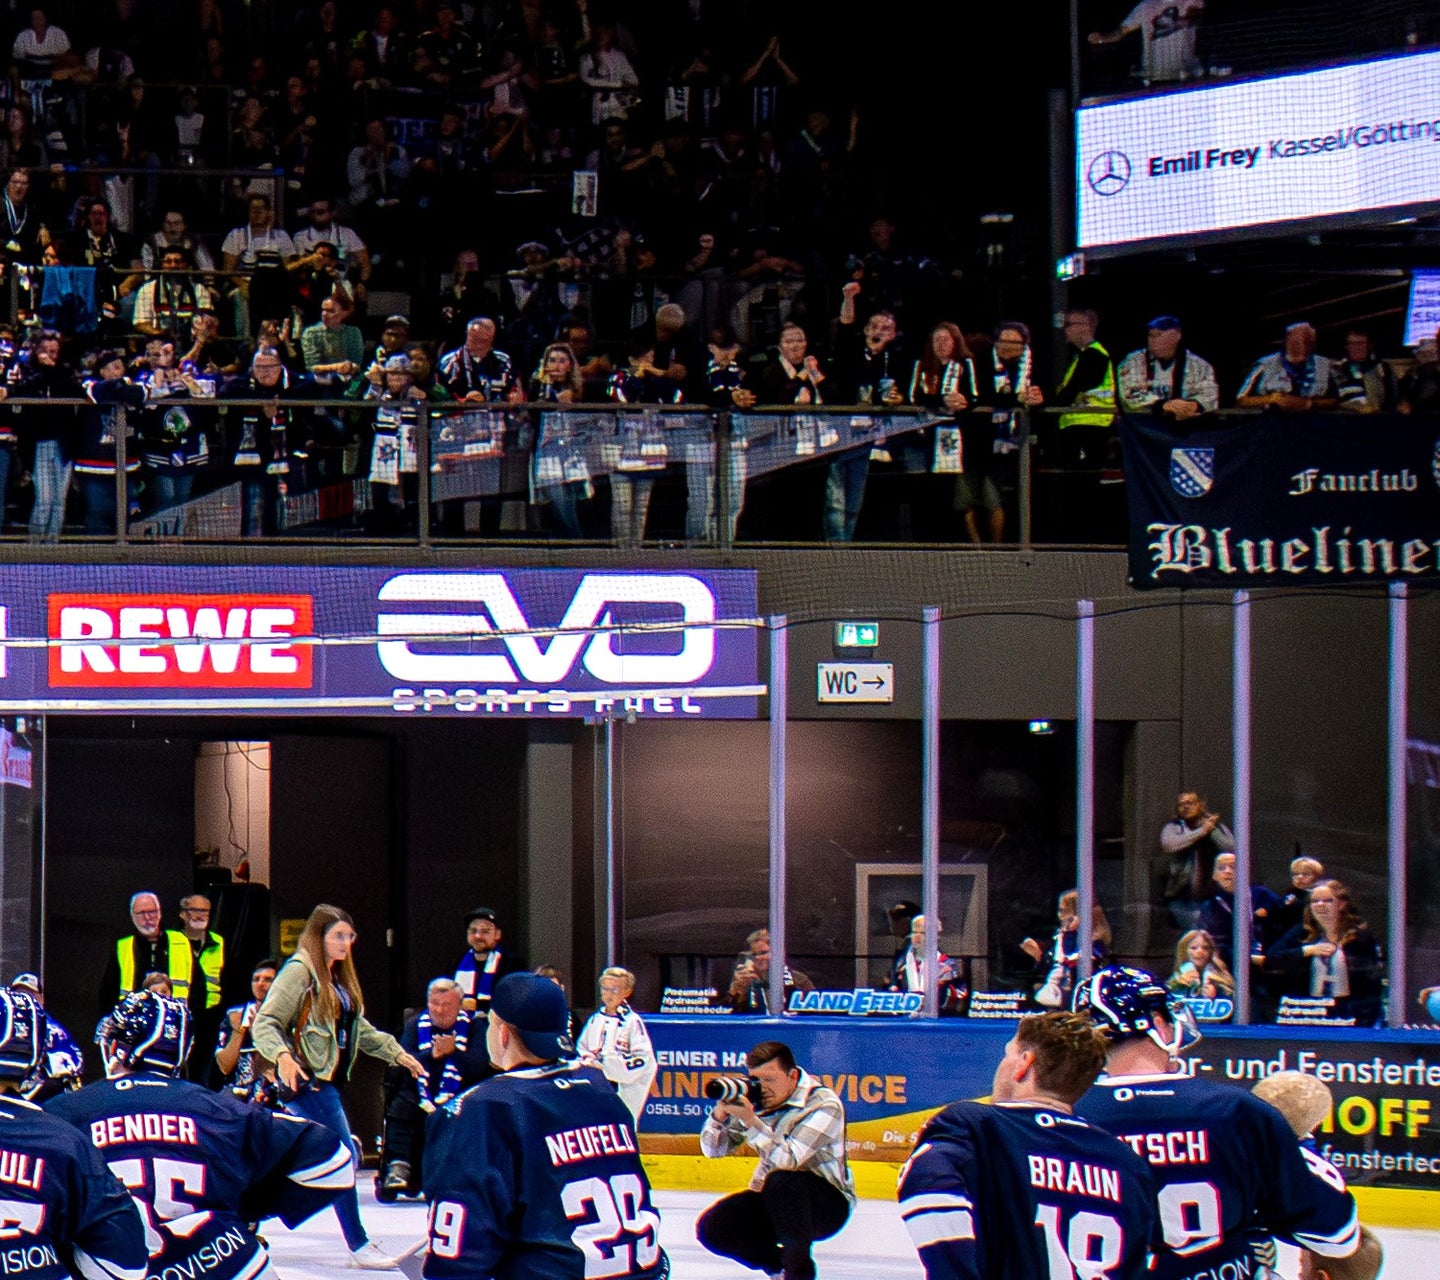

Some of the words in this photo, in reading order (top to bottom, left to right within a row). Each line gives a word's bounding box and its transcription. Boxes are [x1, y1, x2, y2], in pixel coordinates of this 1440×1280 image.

[1148, 149, 1202, 177] Emil
[1206, 142, 1262, 170] Frey
[1288, 468, 1418, 496] Fanclub
[58, 606, 302, 675] REWE
[376, 572, 718, 684] EVO
[825, 670, 859, 695] WC
[788, 987, 924, 1016] LANDEFELD
[657, 1050, 718, 1067] EINER
[646, 1103, 681, 1116] 0561
[683, 1103, 701, 1116] 50
[89, 1115, 199, 1148] BENDER
[543, 1121, 635, 1167] NEUFELD
[1126, 1129, 1210, 1165] TSCH
[1026, 1153, 1122, 1203] BRAUN
[427, 1200, 468, 1259] 9
[559, 1173, 663, 1280] 29
